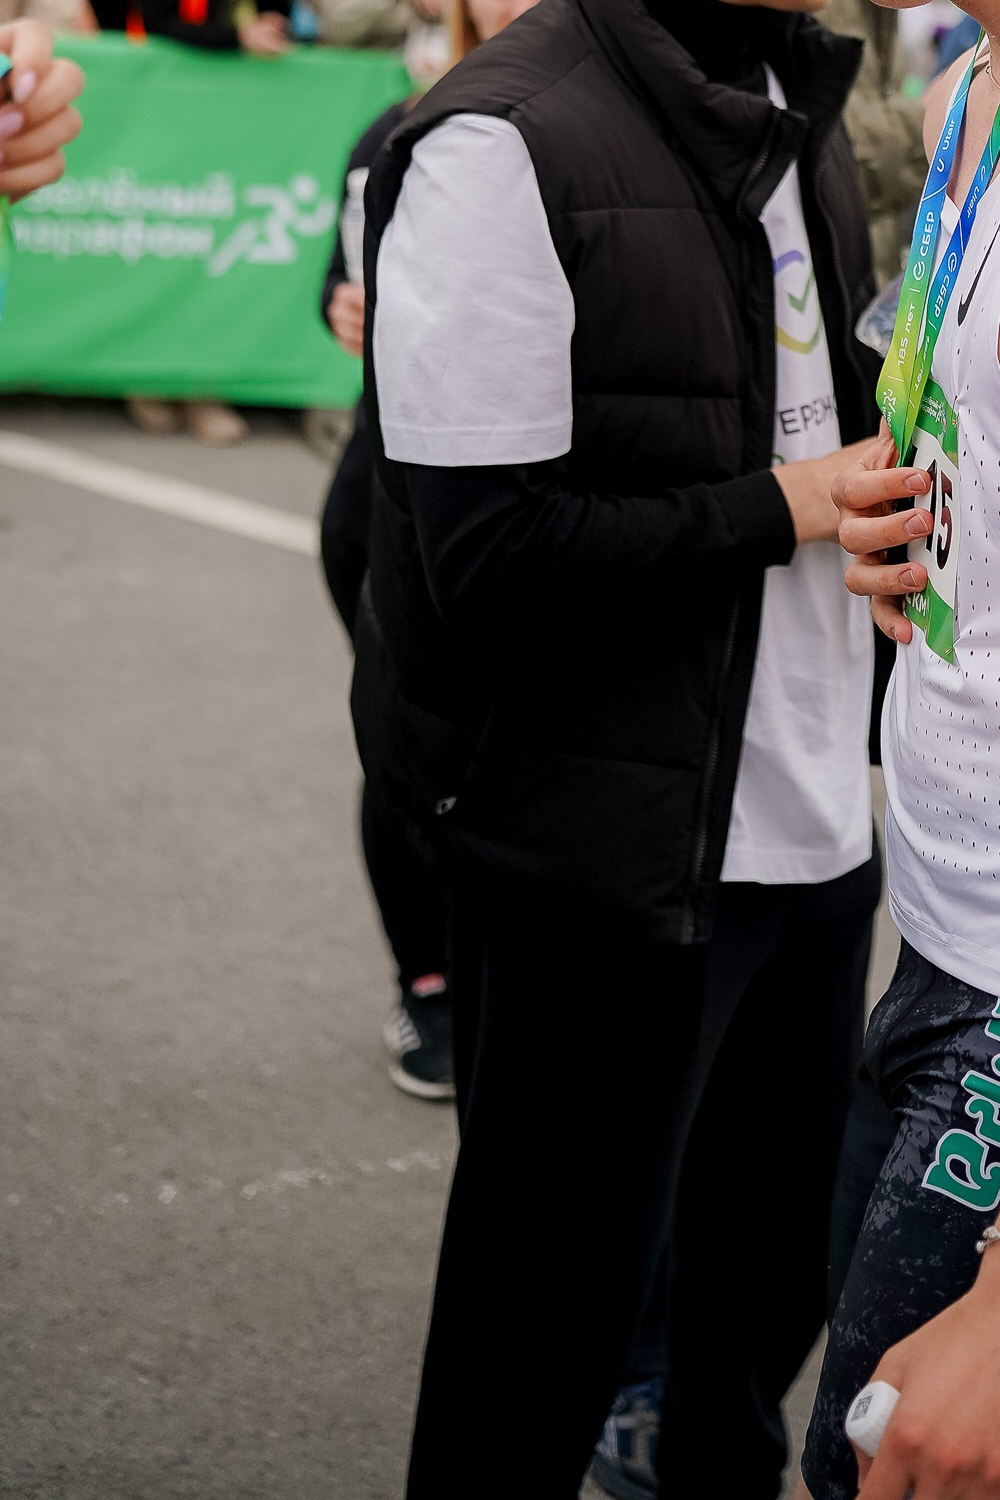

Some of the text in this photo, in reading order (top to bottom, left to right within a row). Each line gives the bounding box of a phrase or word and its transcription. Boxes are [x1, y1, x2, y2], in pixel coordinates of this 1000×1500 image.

[942, 119, 955, 150] Utair
[920, 211, 935, 257] СБЕР
[935, 274, 950, 318] СБЕР
[897, 302, 915, 367] 185 лет
